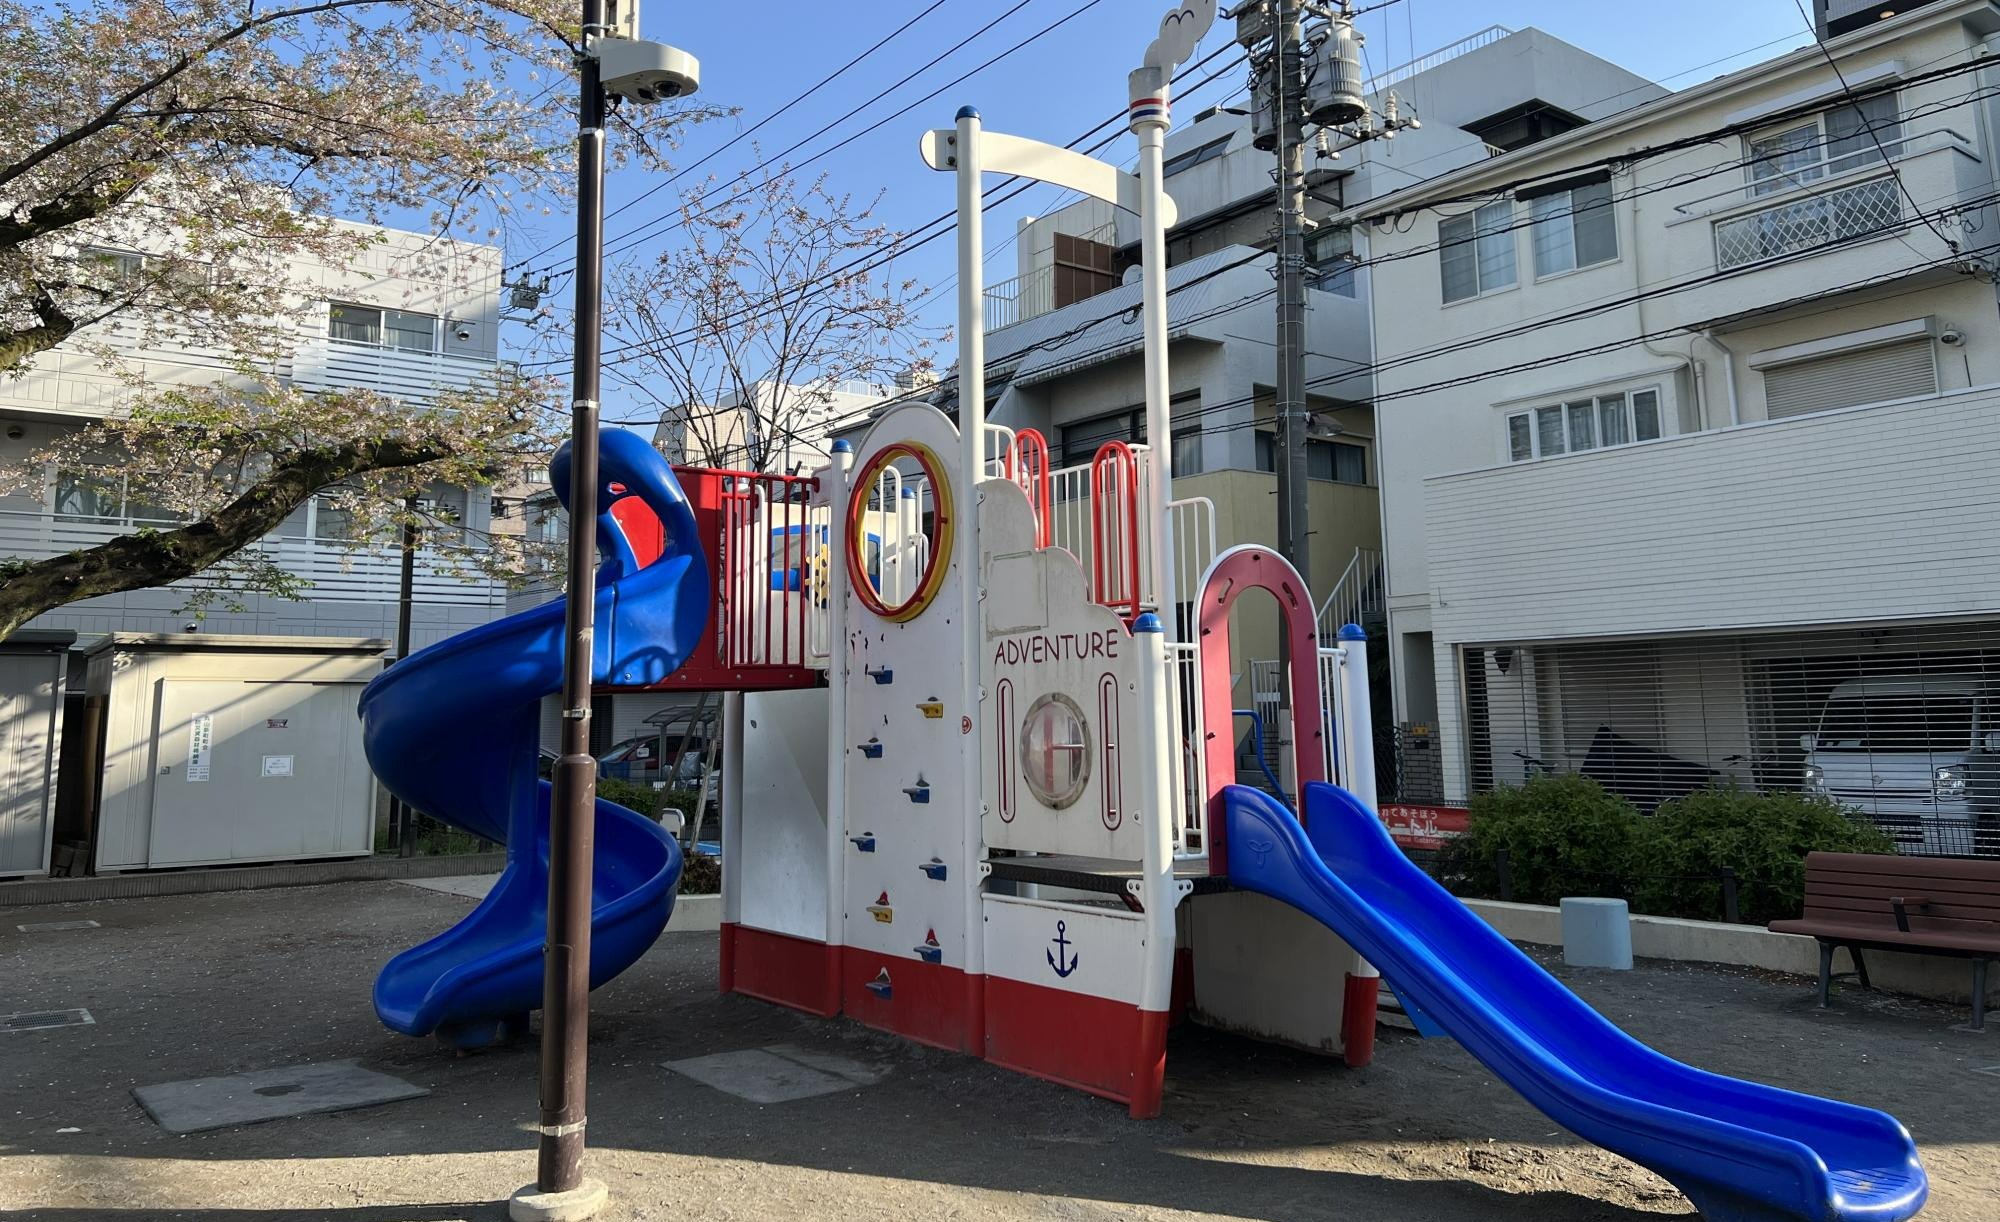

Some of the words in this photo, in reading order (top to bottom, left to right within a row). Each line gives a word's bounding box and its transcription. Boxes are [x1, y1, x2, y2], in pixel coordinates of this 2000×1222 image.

[994, 629, 1118, 665] ADVENTURE
[1377, 808, 1438, 819] れてあそぼう
